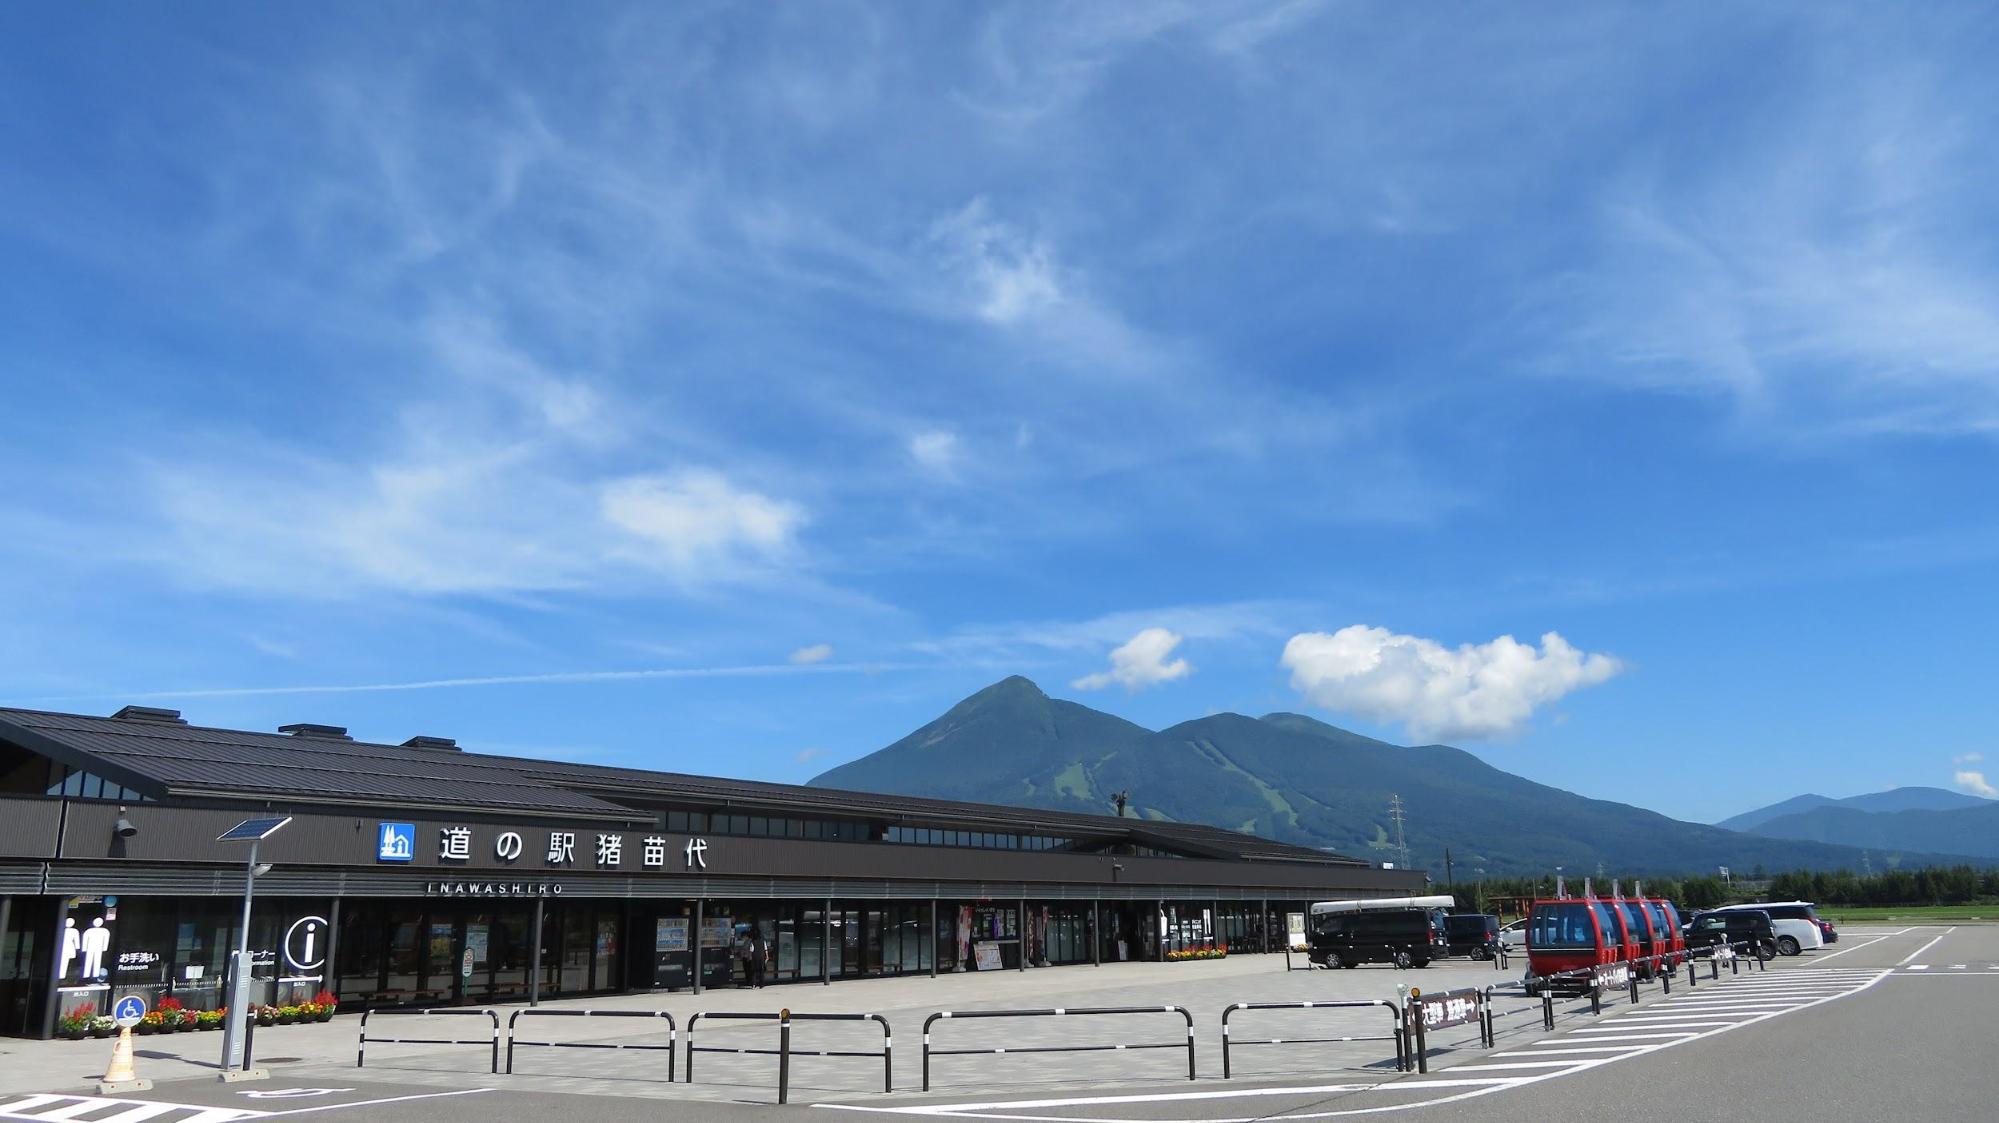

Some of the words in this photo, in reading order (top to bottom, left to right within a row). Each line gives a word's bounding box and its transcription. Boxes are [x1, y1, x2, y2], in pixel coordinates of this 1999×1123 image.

[440, 826, 708, 868] 道の駅猪苗代
[427, 883, 562, 895] INAWASHIRO
[119, 951, 160, 964] お手洗い
